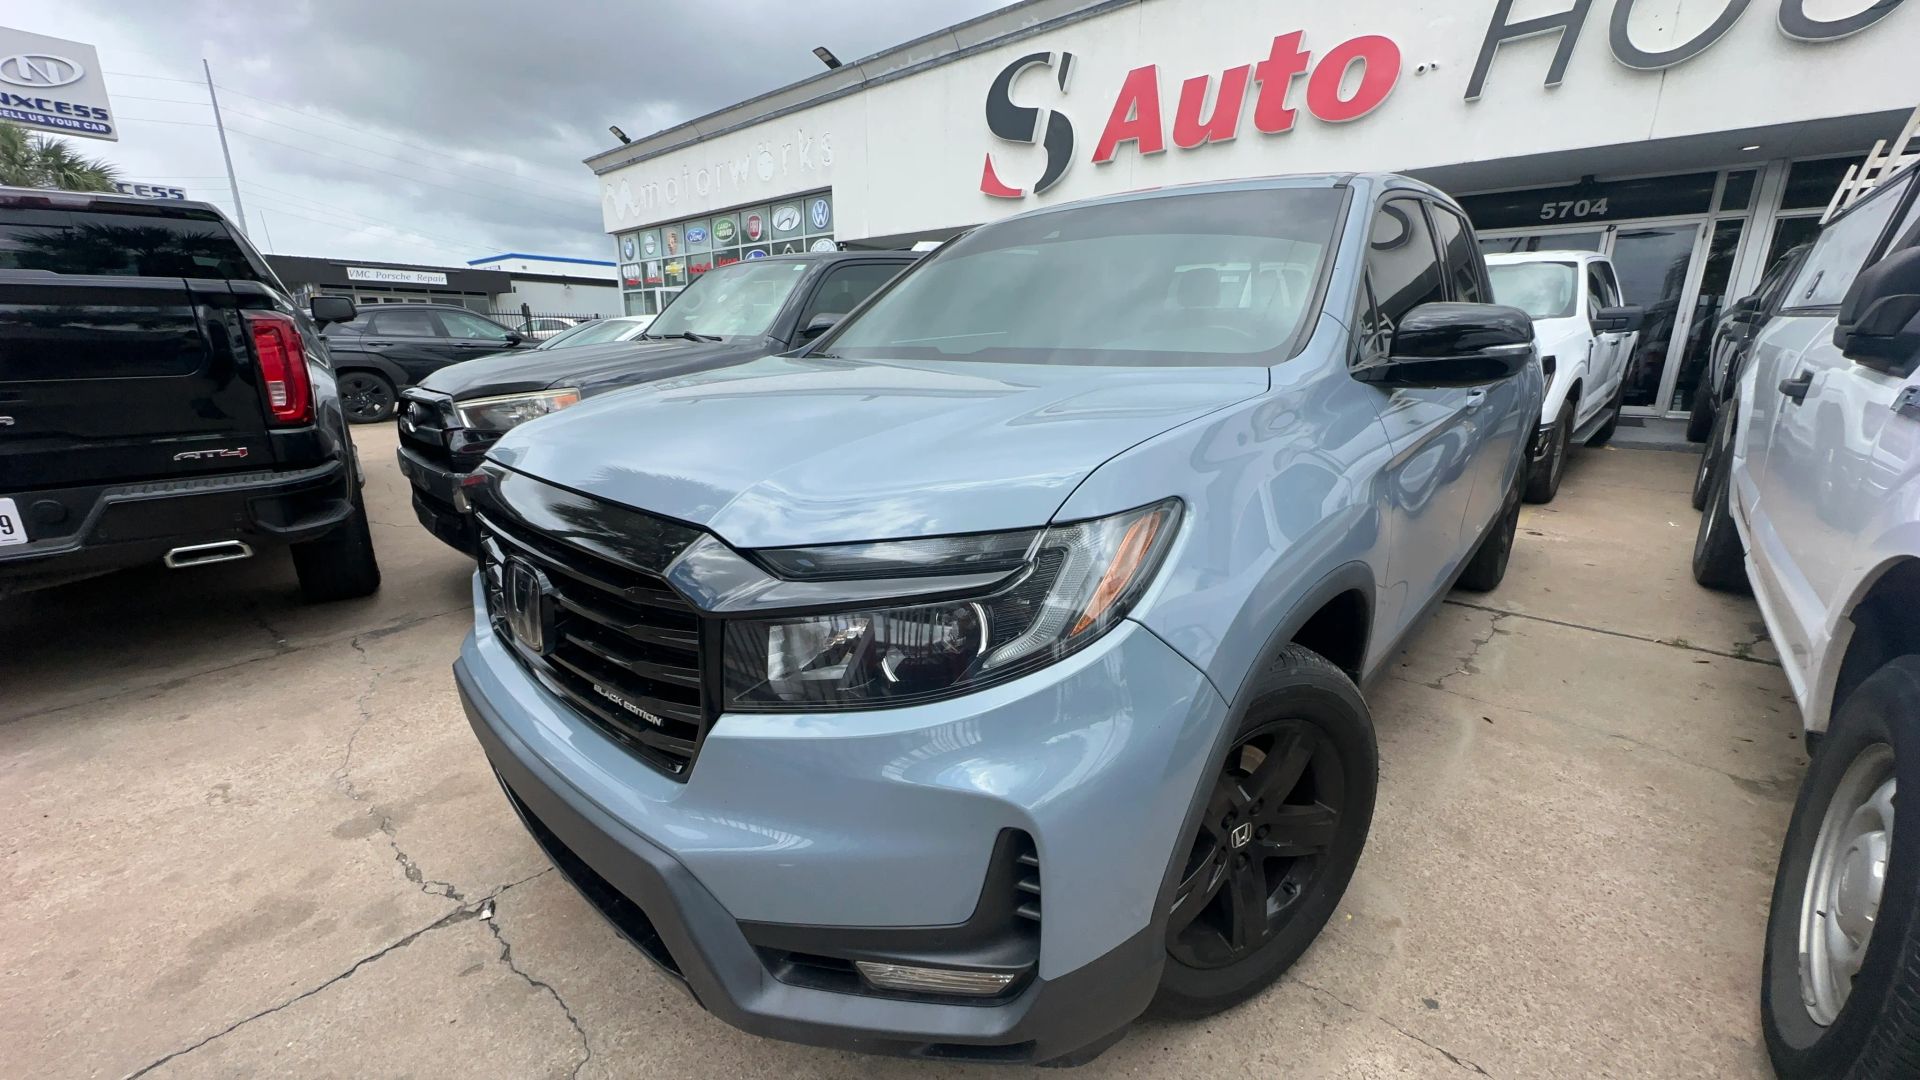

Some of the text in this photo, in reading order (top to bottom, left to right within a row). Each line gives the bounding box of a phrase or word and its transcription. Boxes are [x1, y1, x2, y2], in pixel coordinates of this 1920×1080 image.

[1464, 0, 1905, 102] HO
[1091, 29, 1402, 165] Auto
[0, 109, 107, 132] ELL US YOUR CAR
[1540, 197, 1609, 220] 5704
[348, 269, 446, 284] VMC Porsche Repair
[593, 683, 663, 727] BLACK EDITION
